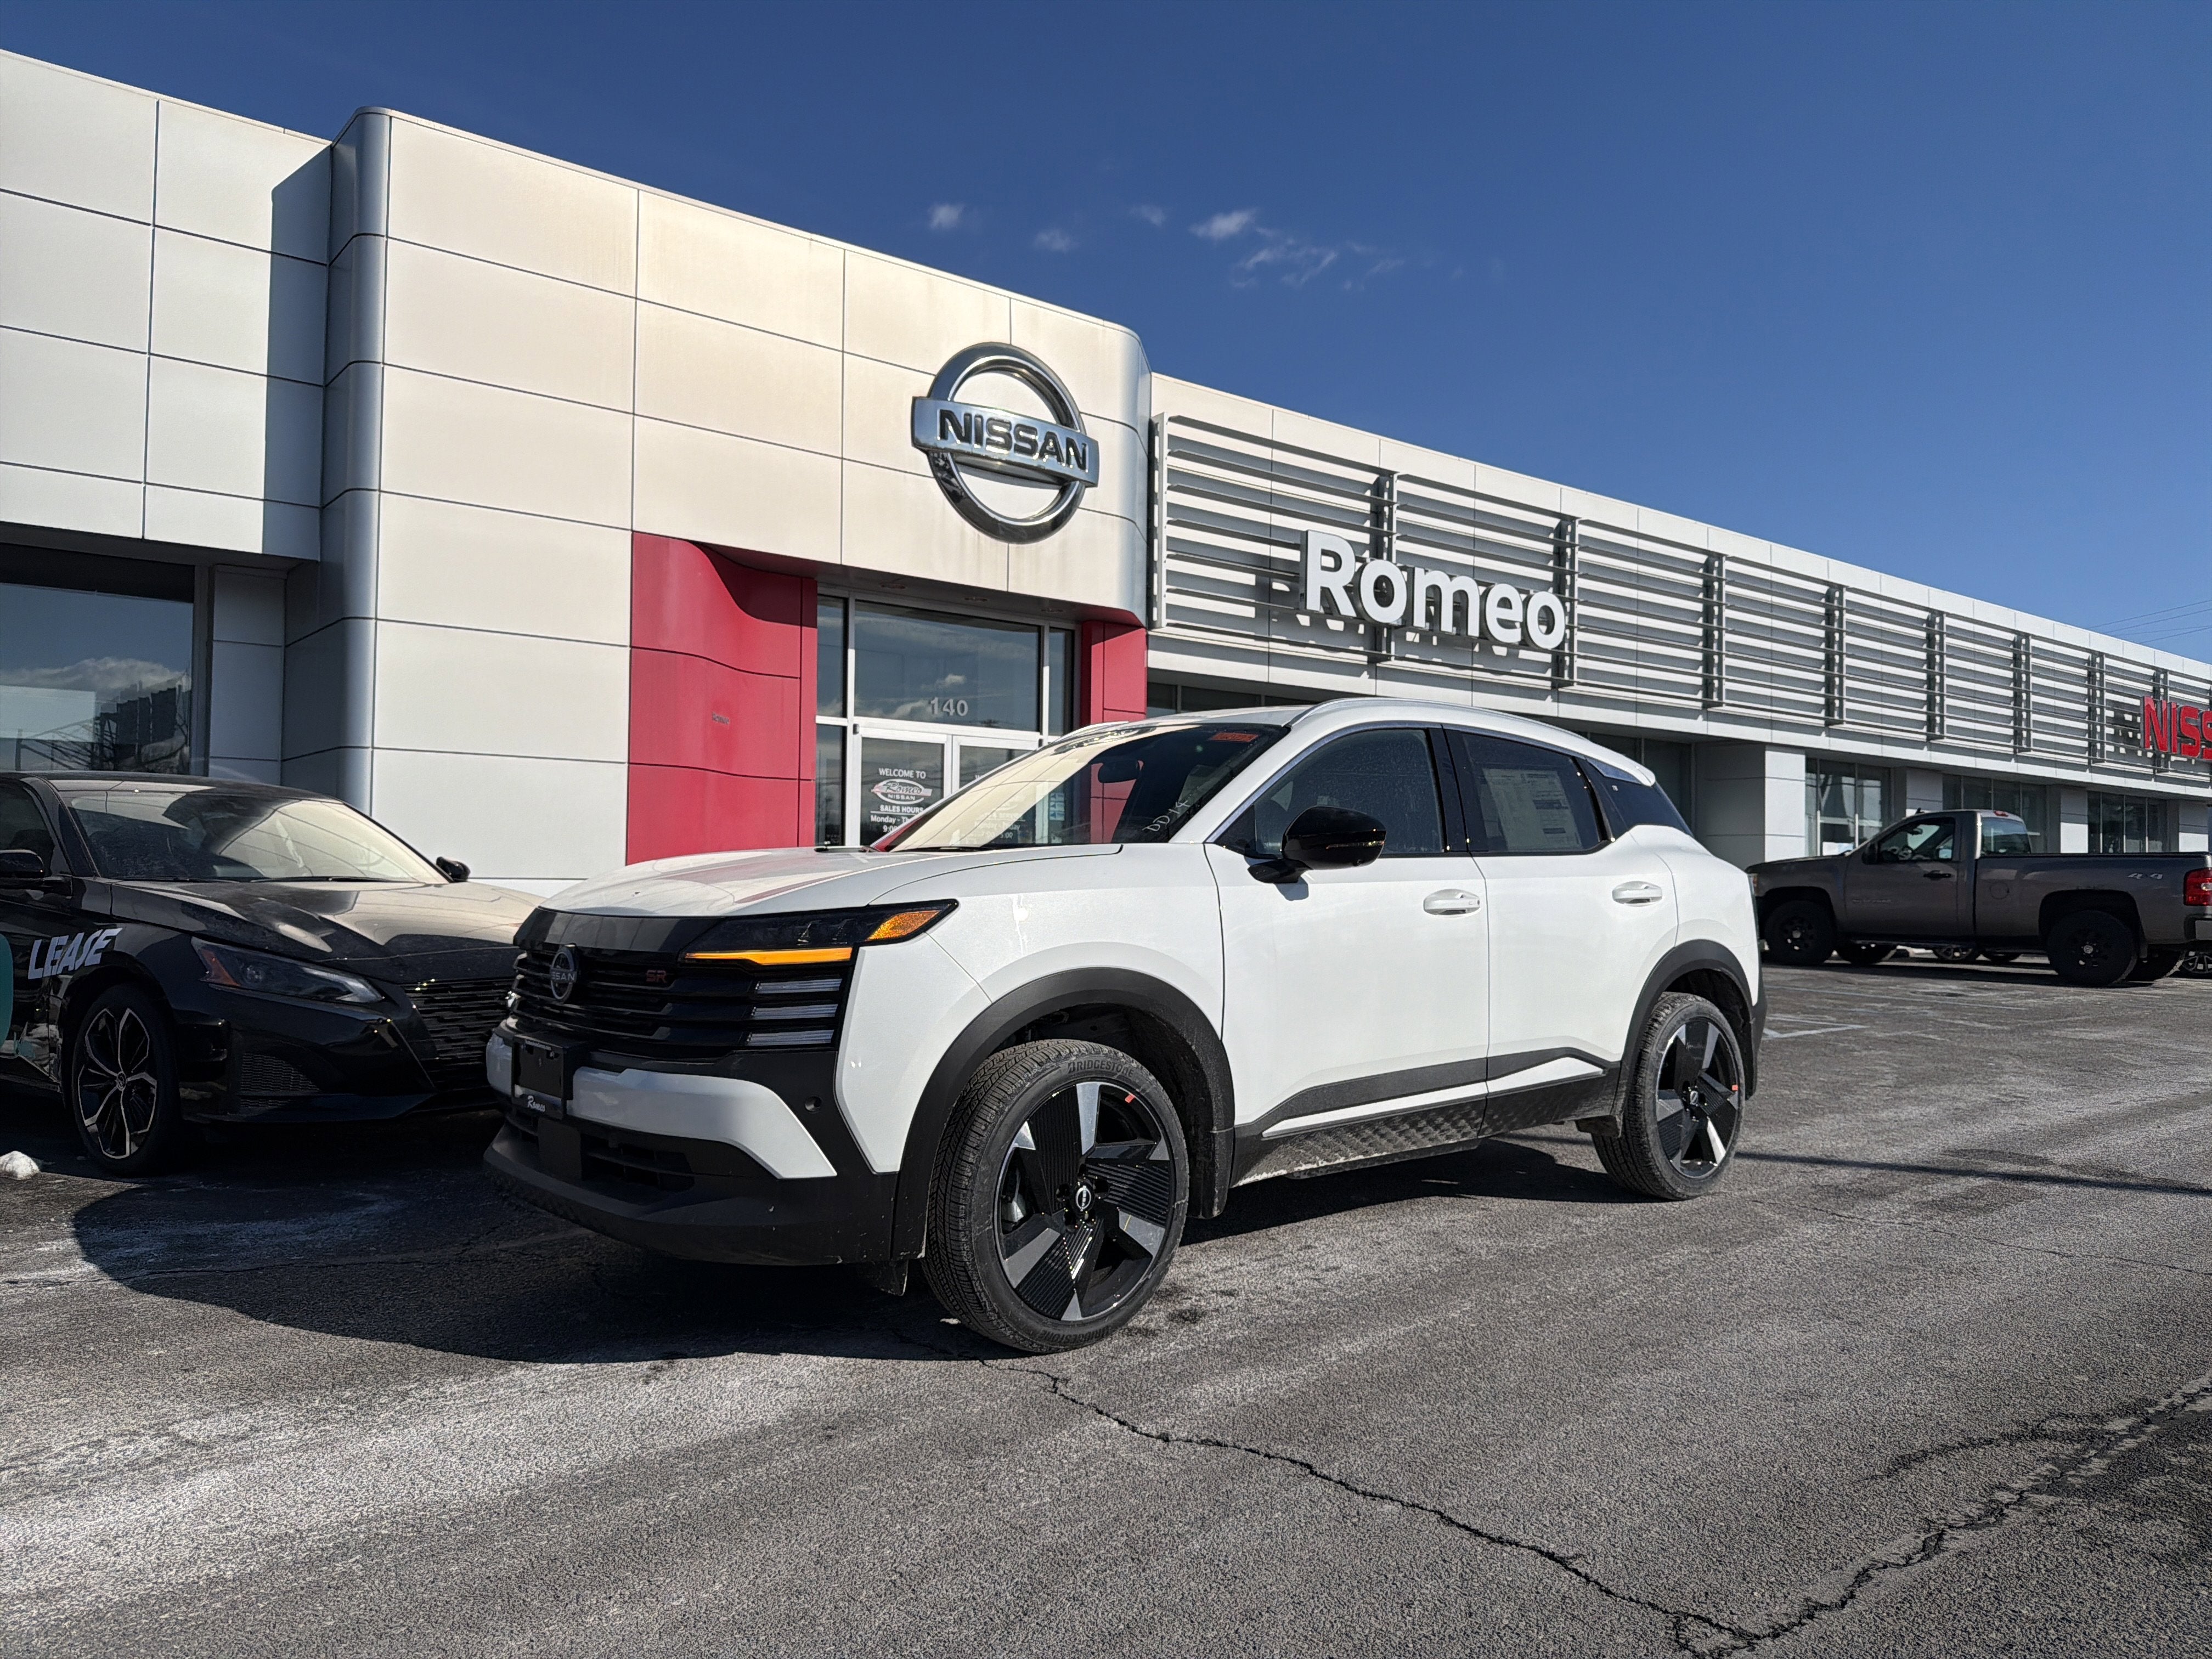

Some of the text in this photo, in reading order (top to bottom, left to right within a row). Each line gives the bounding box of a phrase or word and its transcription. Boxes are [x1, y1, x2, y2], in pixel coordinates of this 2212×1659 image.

[936, 409, 1089, 473] NISSAN
[1305, 529, 1566, 650] Romeo
[930, 696, 968, 716] 140
[879, 768, 926, 779] WELCOME TO
[886, 781, 922, 794] Romeo
[870, 815, 896, 825] Monday
[28, 928, 123, 979] LEASE
[646, 969, 667, 983] SR
[1066, 1059, 1134, 1077] BRIDGESTONE
